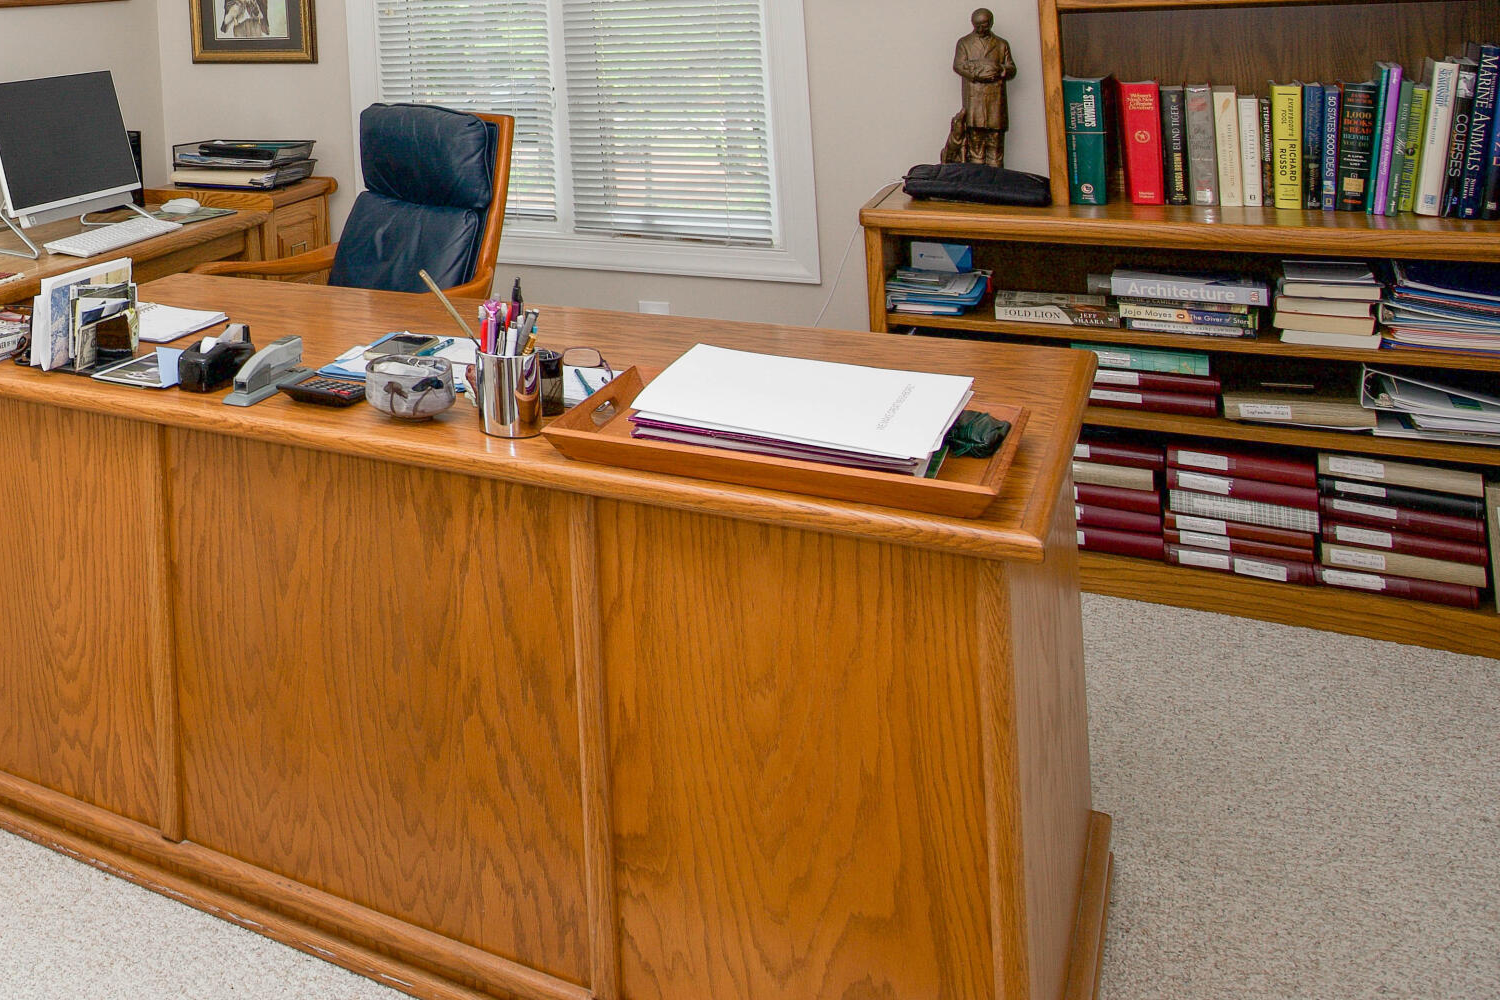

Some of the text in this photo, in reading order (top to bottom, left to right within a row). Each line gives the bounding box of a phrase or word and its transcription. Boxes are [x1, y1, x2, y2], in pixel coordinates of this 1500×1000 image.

[1083, 94, 1097, 128] STEDMAN'S
[1262, 106, 1270, 134] STEPHEN
[1343, 119, 1373, 127] BOOKS
[1466, 53, 1500, 171] MARINE ANIMALS
[1170, 104, 1181, 150] BLIND TIGER
[1325, 96, 1337, 178] 50 STATES 5000 IDEAS
[1448, 114, 1469, 177] COURSES
[1279, 148, 1287, 177] RUSSO
[1288, 143, 1297, 182] RICHARD
[1127, 282, 1236, 301] Architecture
[1008, 309, 1061, 319] OLD LION
[1123, 308, 1142, 317] Jojo
[1144, 309, 1173, 319] Moyes
[1190, 313, 1202, 321] The
[1204, 315, 1223, 323] Giver
